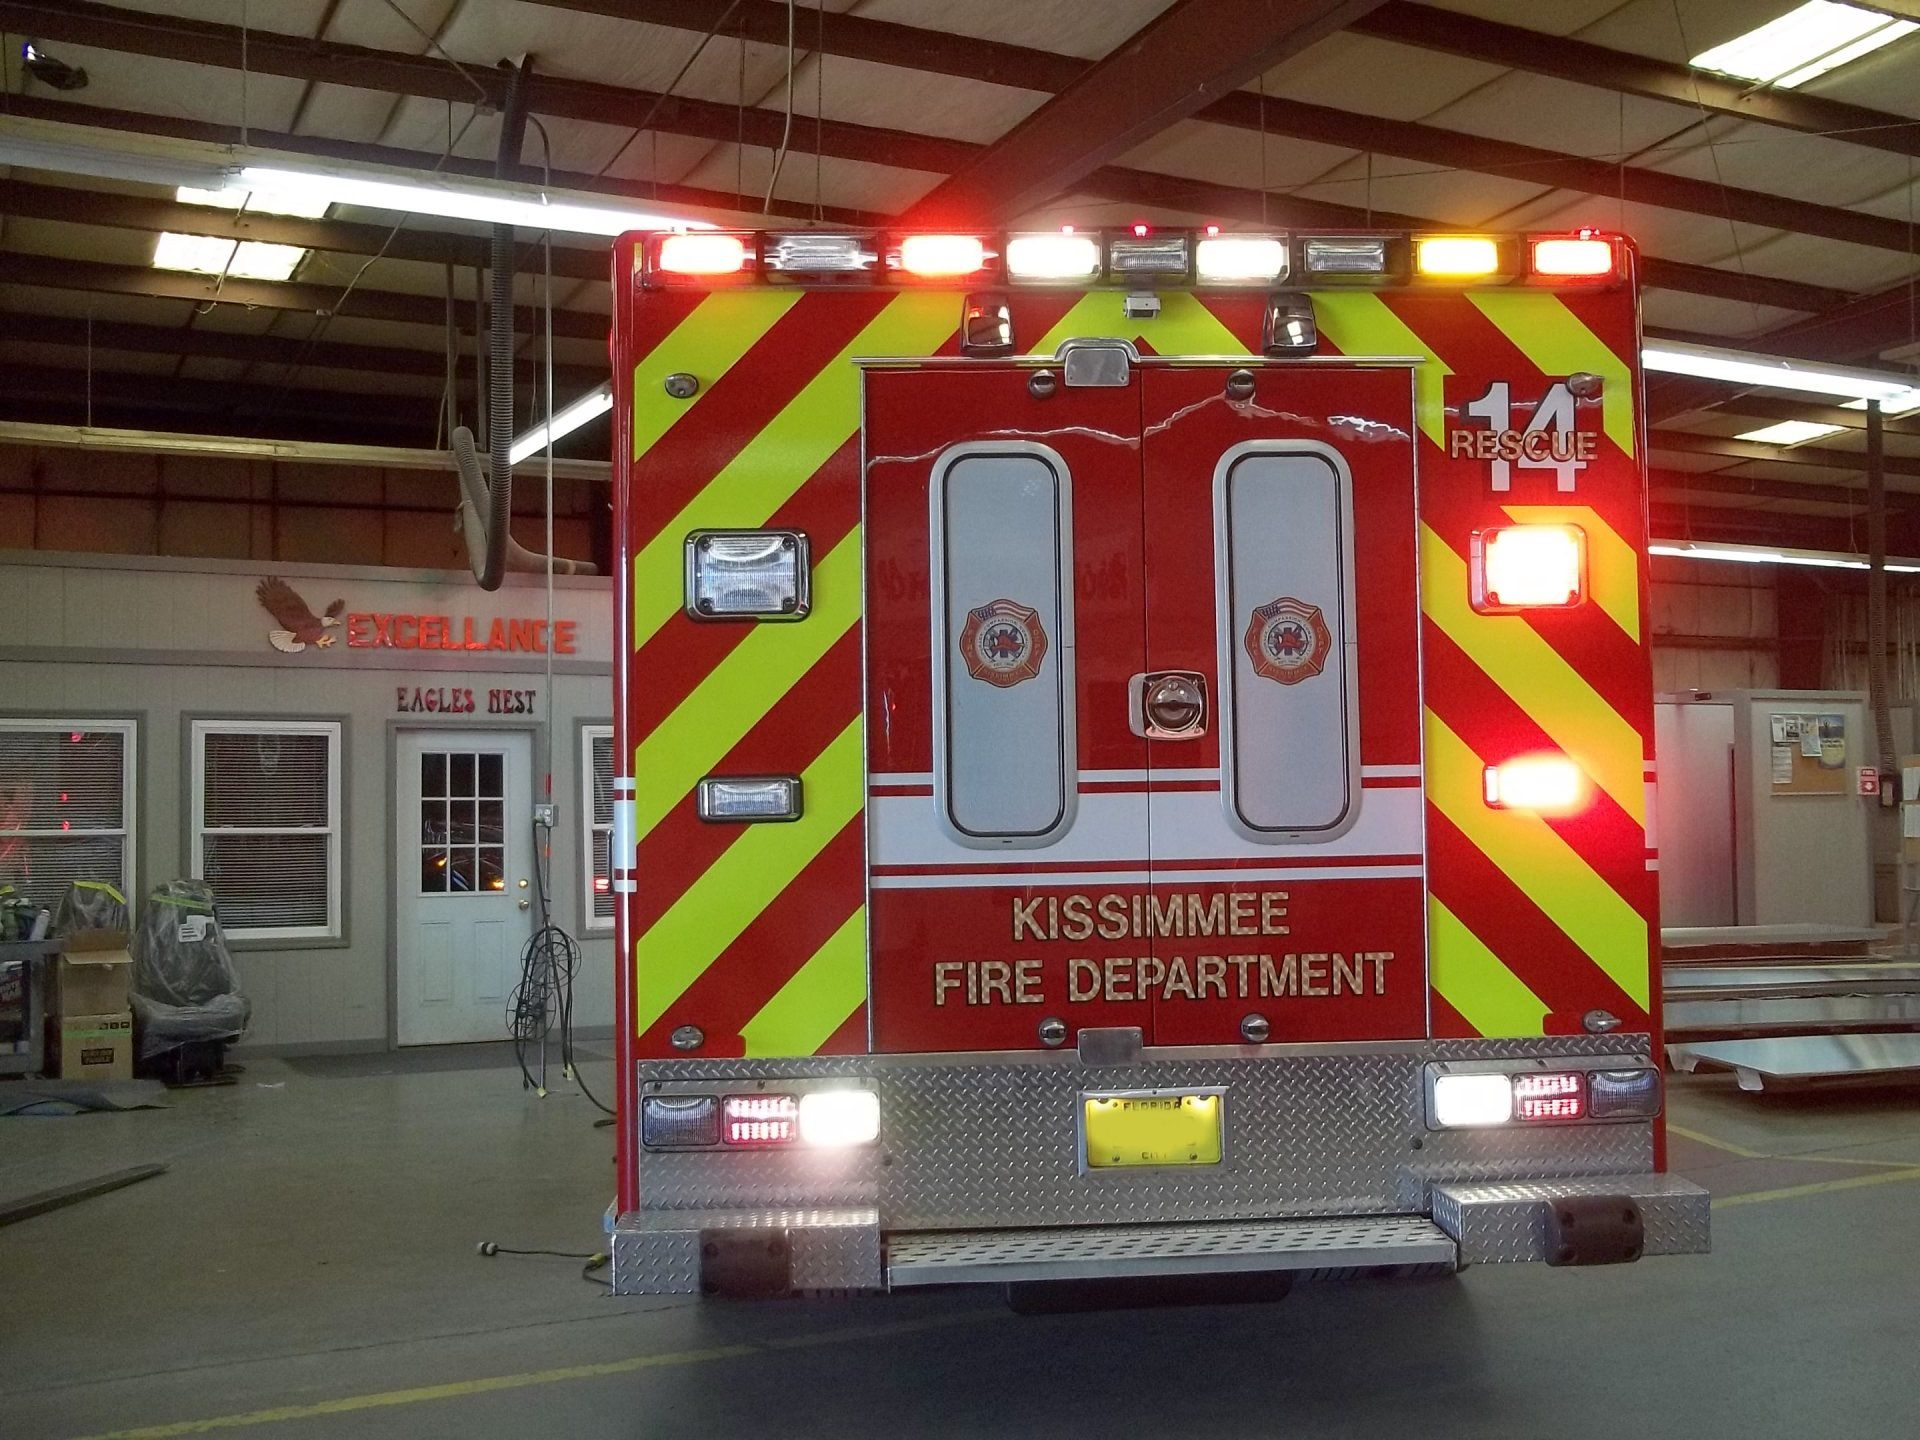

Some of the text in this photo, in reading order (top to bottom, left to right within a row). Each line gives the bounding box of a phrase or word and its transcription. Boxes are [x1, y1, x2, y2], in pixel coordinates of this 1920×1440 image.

[1451, 430, 1598, 462] RESCUE
[1468, 382, 1587, 492] 14
[347, 613, 577, 653] EXCELLANCE
[397, 687, 537, 714] EAGLES NEST
[1013, 892, 1290, 941] KISSIMMEE
[935, 952, 1395, 1005] FIRE DEPARTMENT
[1123, 1101, 1181, 1110] FLORIDA
